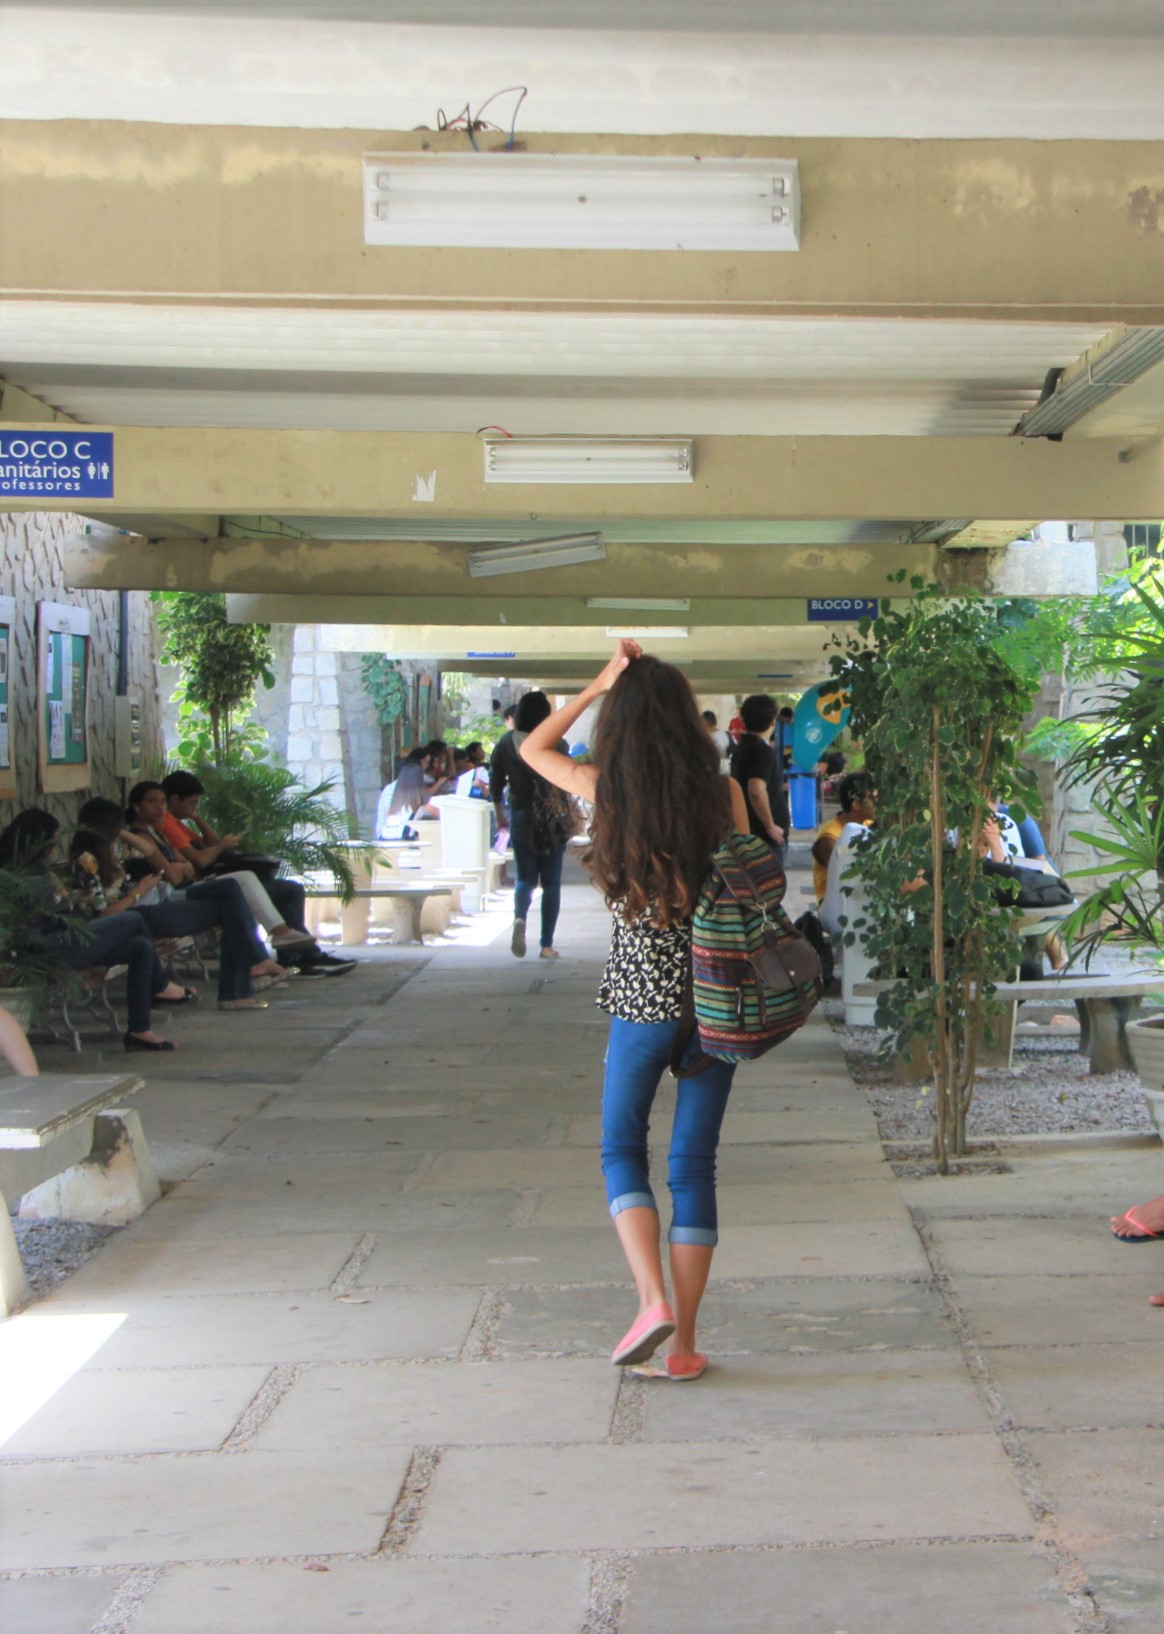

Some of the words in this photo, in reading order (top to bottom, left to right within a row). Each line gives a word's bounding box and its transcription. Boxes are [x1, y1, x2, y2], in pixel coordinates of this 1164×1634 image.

[0, 440, 68, 459] LOCO
[74, 441, 91, 460] C
[0, 460, 81, 479] anitários
[1, 478, 81, 491] ofessores
[811, 599, 851, 610] BLOCO
[854, 599, 864, 610] D
